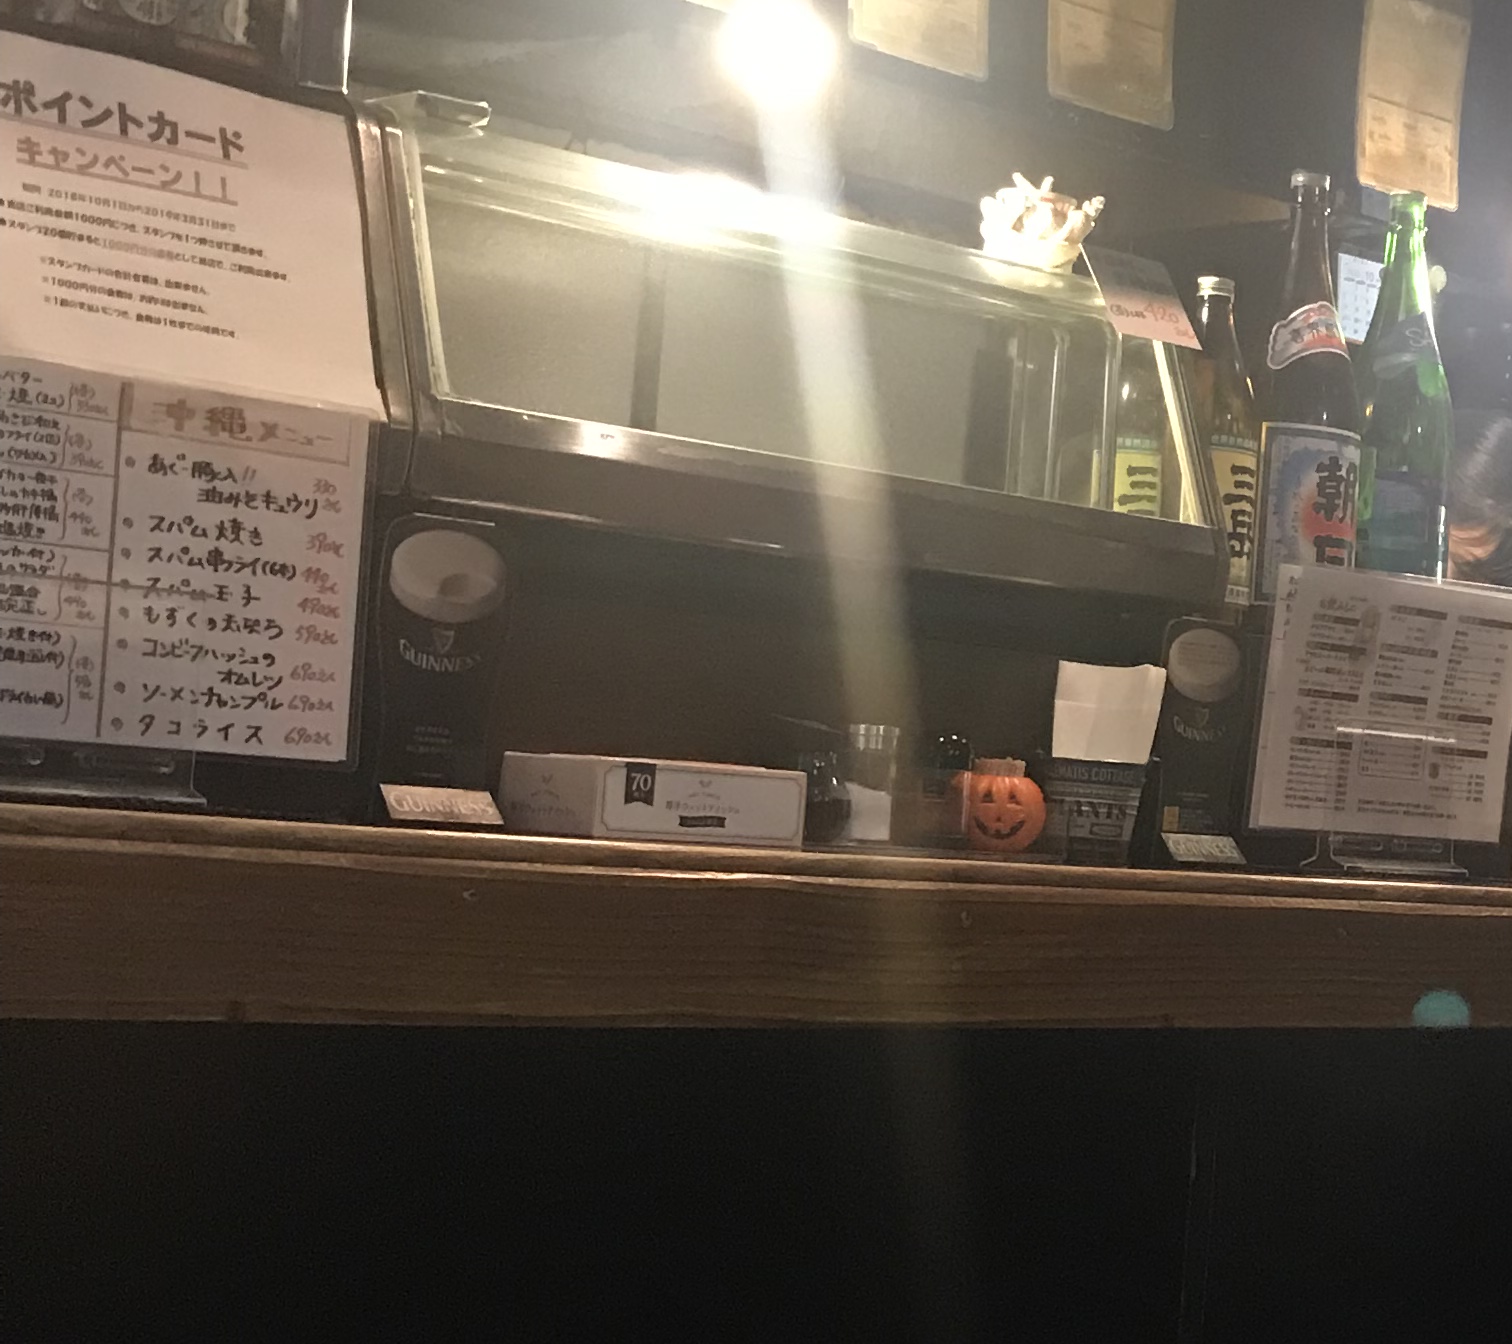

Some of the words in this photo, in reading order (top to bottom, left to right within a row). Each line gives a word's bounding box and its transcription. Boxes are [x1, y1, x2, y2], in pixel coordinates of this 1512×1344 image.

[0, 80, 245, 159] ポイントカード
[138, 713, 264, 746] タコライス
[628, 770, 652, 791] 70
